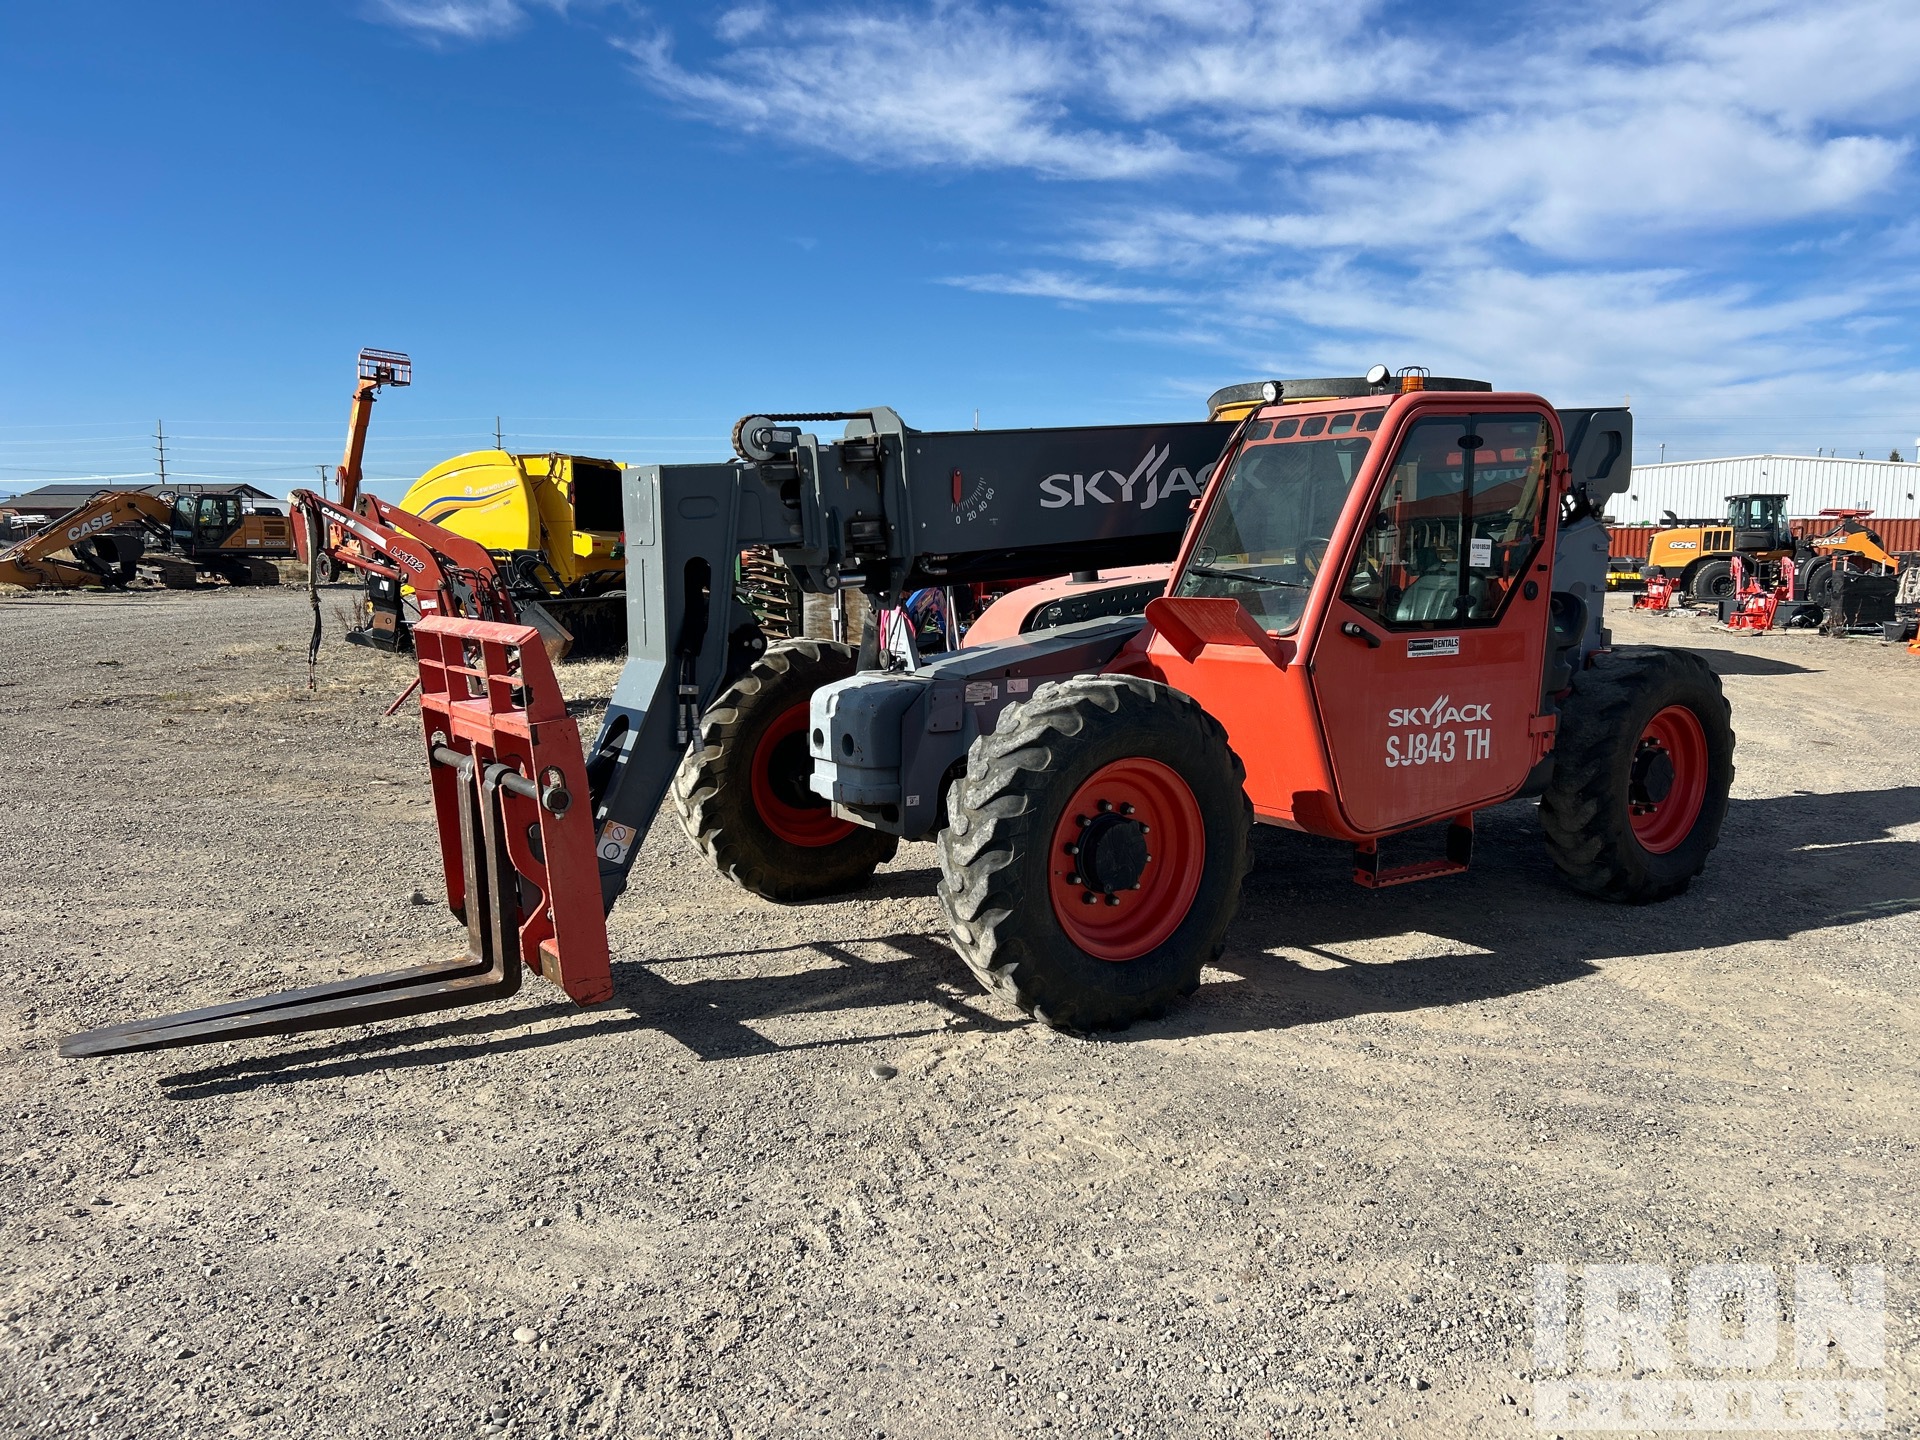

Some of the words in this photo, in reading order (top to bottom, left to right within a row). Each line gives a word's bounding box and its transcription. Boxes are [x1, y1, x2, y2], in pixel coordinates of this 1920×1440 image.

[986, 487, 995, 500] 60
[978, 500, 988, 512] 40
[321, 507, 347, 524] CASE
[955, 515, 961, 524] 0
[967, 510, 977, 521] 20
[67, 511, 114, 541] CASE
[1669, 541, 1697, 549] 621G
[1812, 536, 1848, 546] CASE
[389, 546, 426, 573] LX132
[1433, 638, 1459, 648] RENTALS
[1388, 695, 1492, 729] SKYJACK
[1385, 731, 1456, 768] SJ843
[1464, 728, 1491, 761] TH
